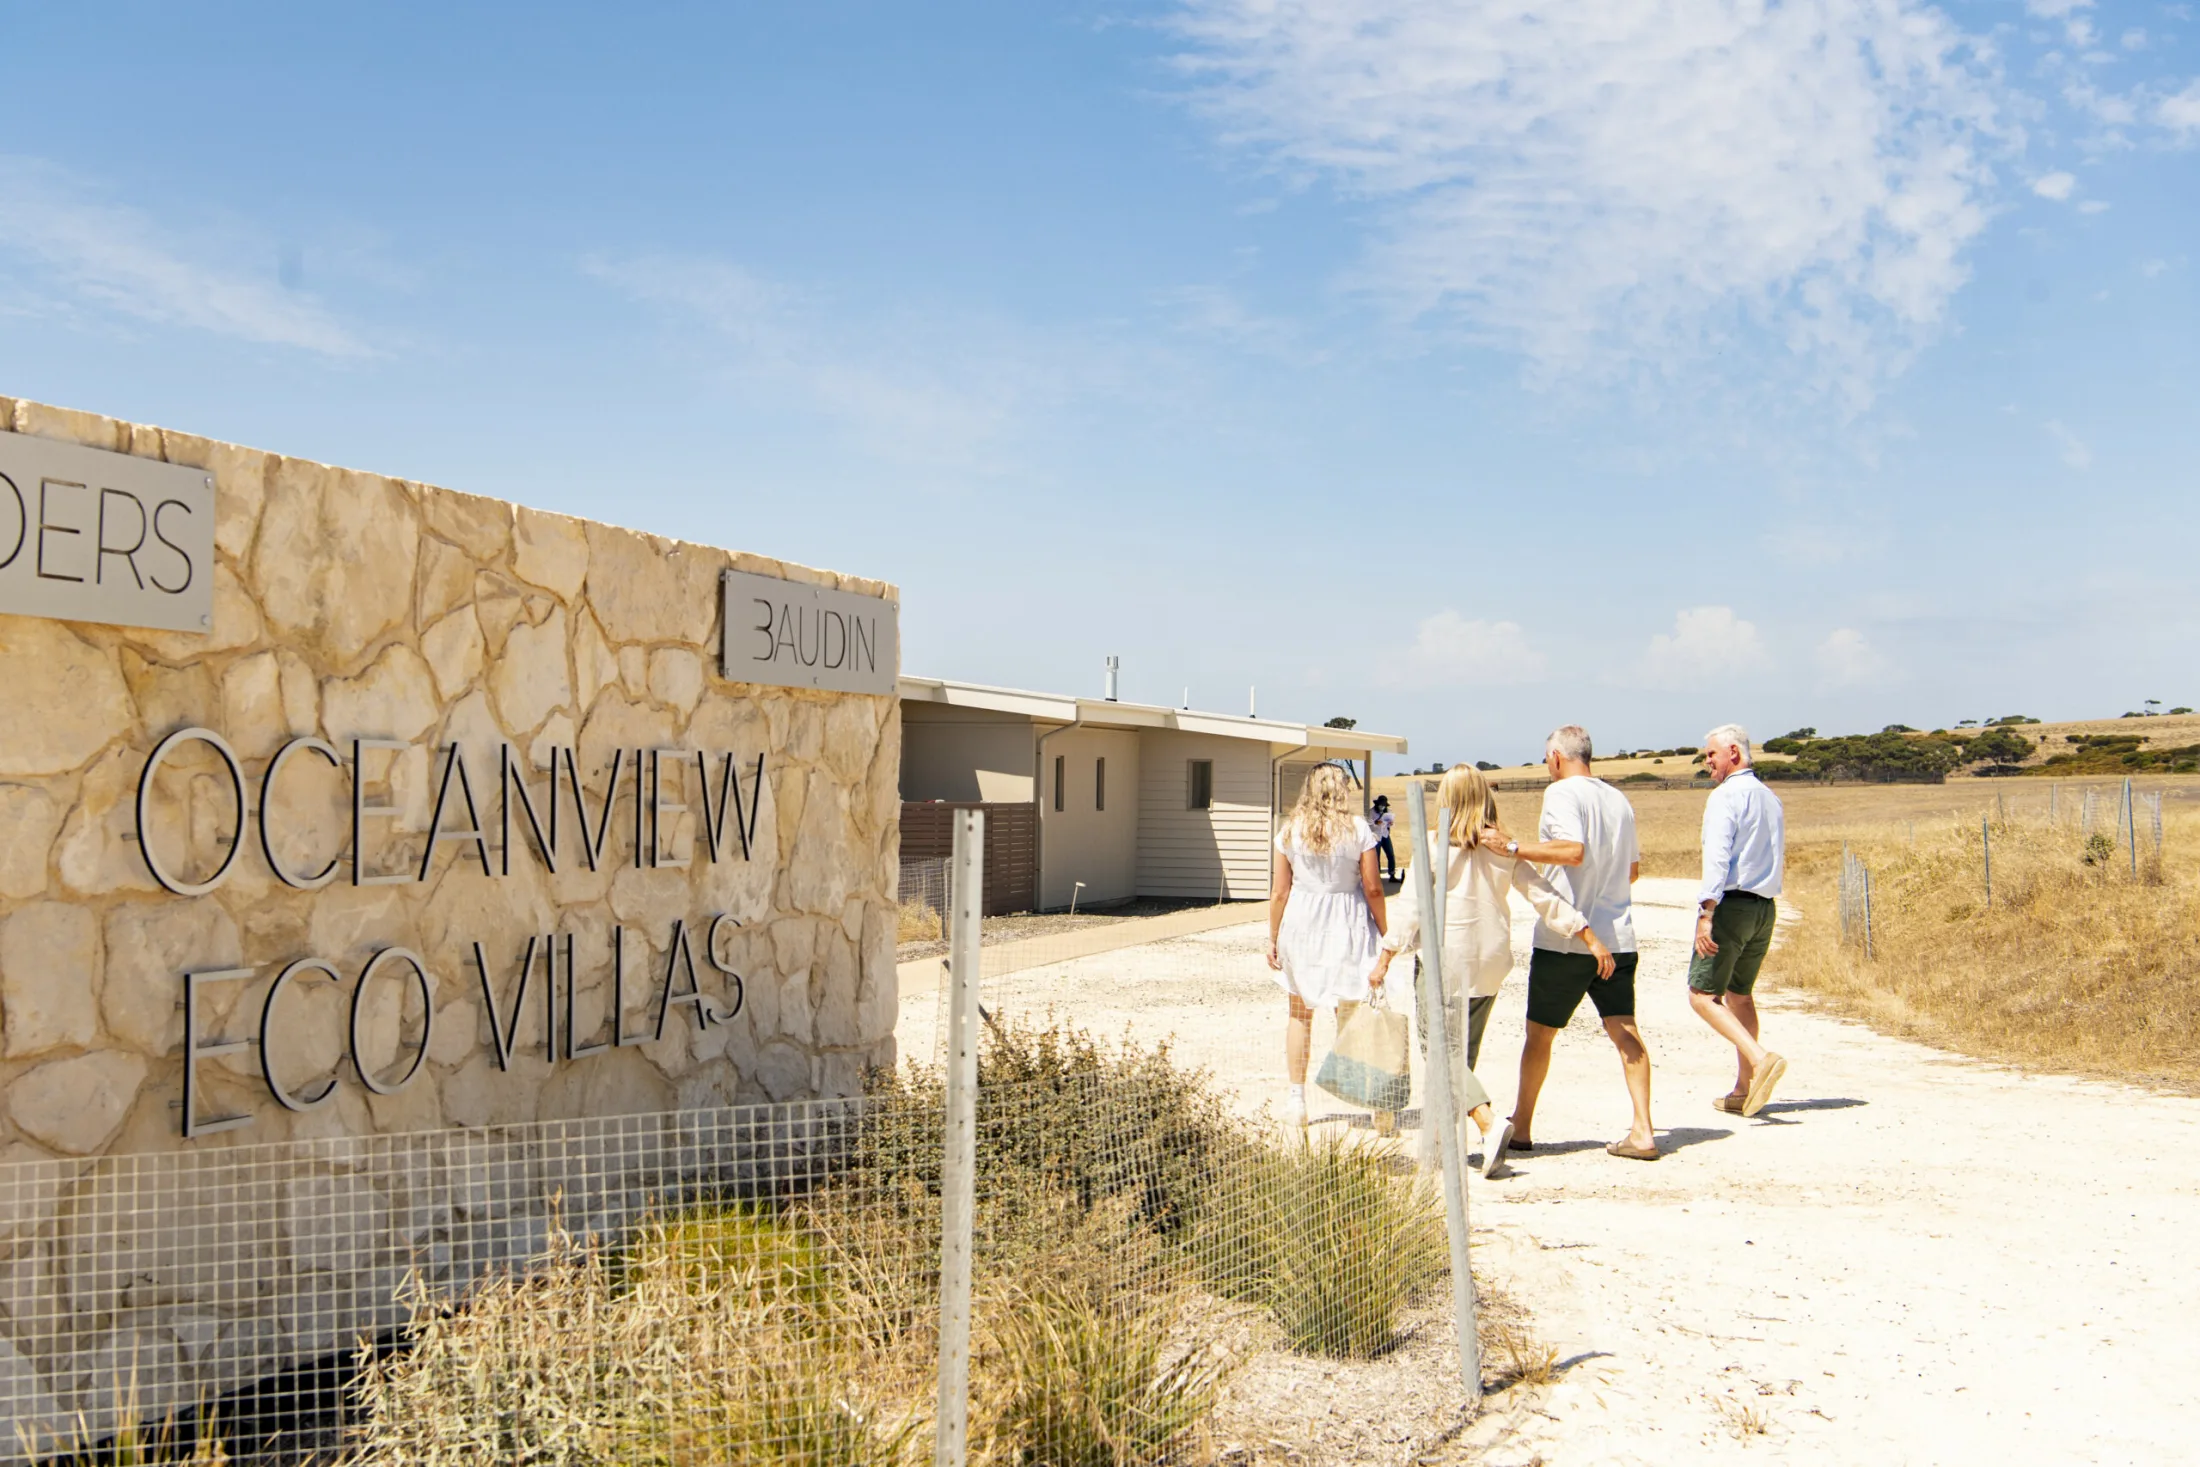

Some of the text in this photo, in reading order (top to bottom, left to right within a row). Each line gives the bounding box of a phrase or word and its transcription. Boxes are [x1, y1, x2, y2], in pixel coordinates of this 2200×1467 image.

[752, 598, 876, 674] BAUDIN
[136, 727, 765, 896] OCEANVIEW
[182, 911, 746, 1137] ECO VILLAS
